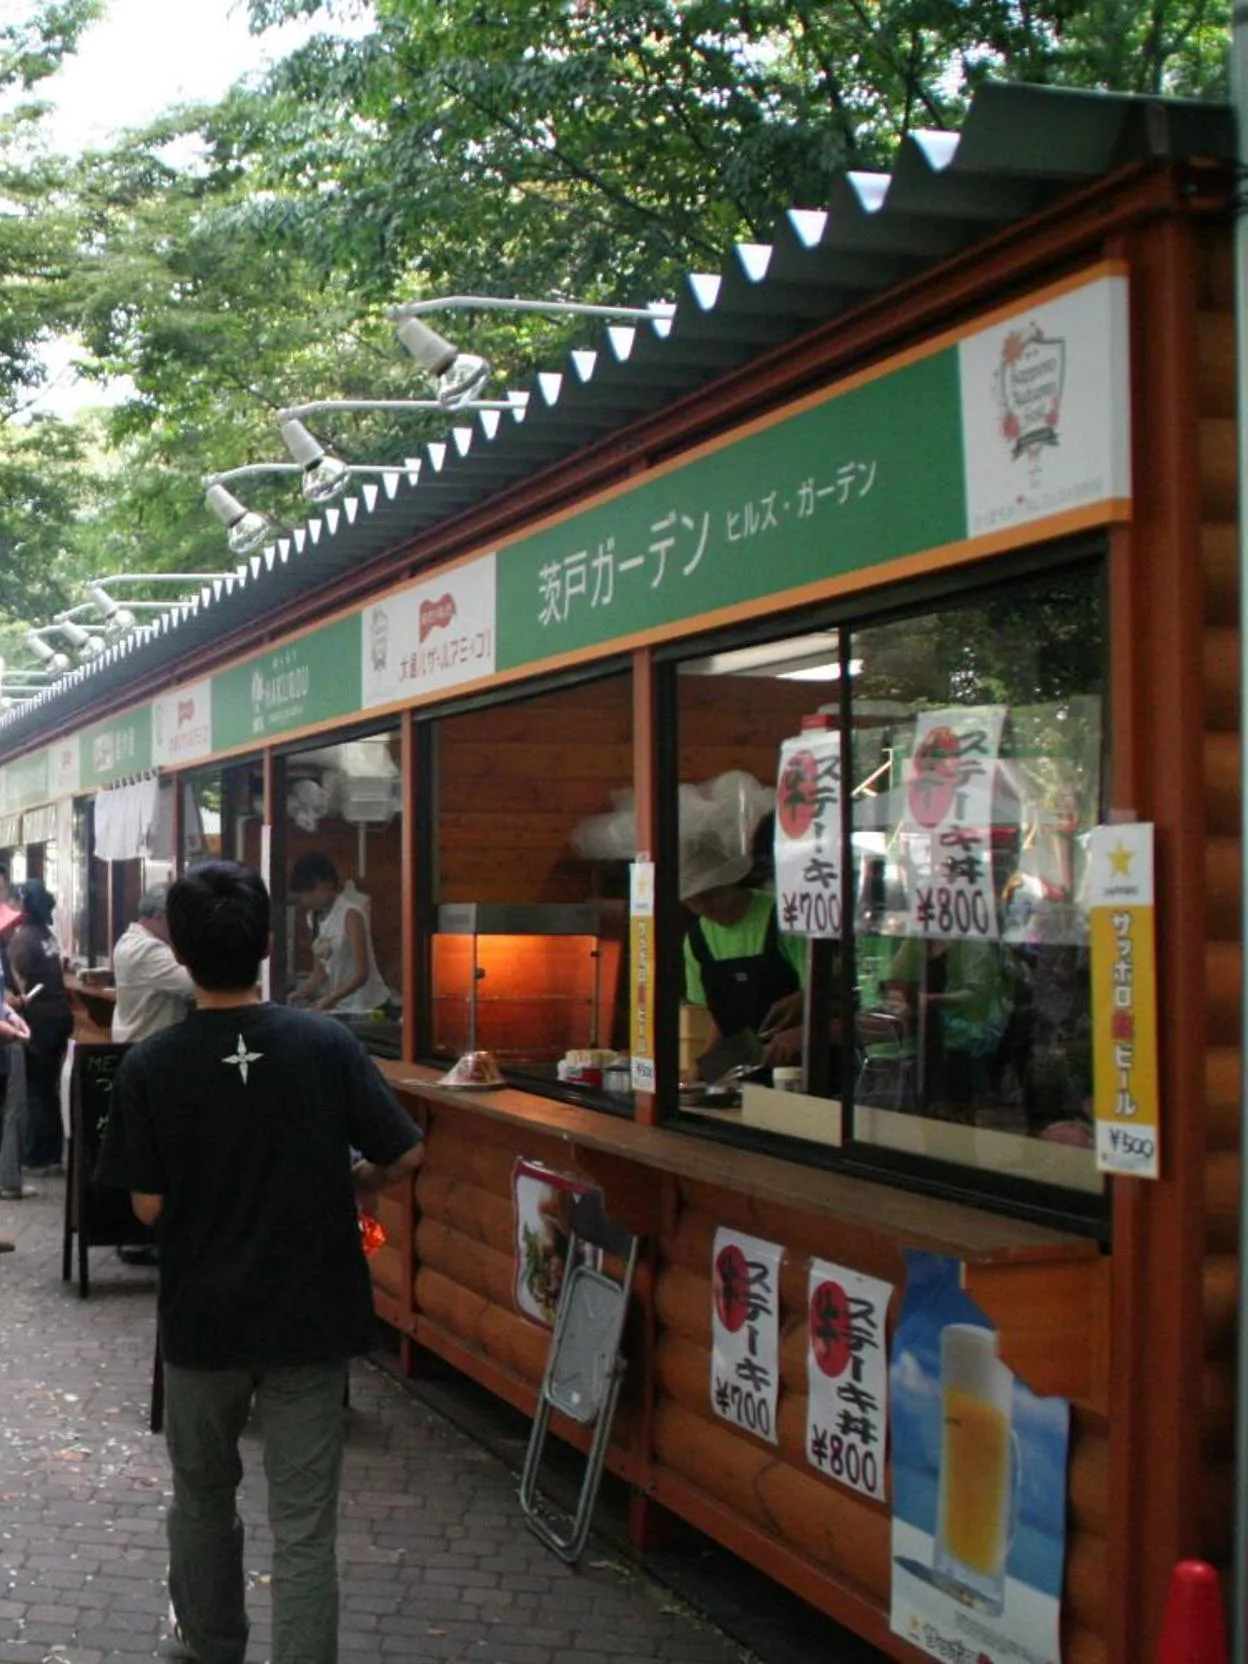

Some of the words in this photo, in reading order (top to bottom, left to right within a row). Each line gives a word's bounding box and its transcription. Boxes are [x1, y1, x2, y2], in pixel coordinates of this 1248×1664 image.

[538, 511, 710, 627] 茨戸ガーデン
[726, 460, 876, 541] ヒルズ・ガーデン
[782, 892, 843, 933] ¥700
[916, 886, 990, 935] ¥800
[1108, 1127, 1155, 1158] ¥500
[715, 1377, 770, 1436] ¥700
[810, 1424, 878, 1493] ¥800
